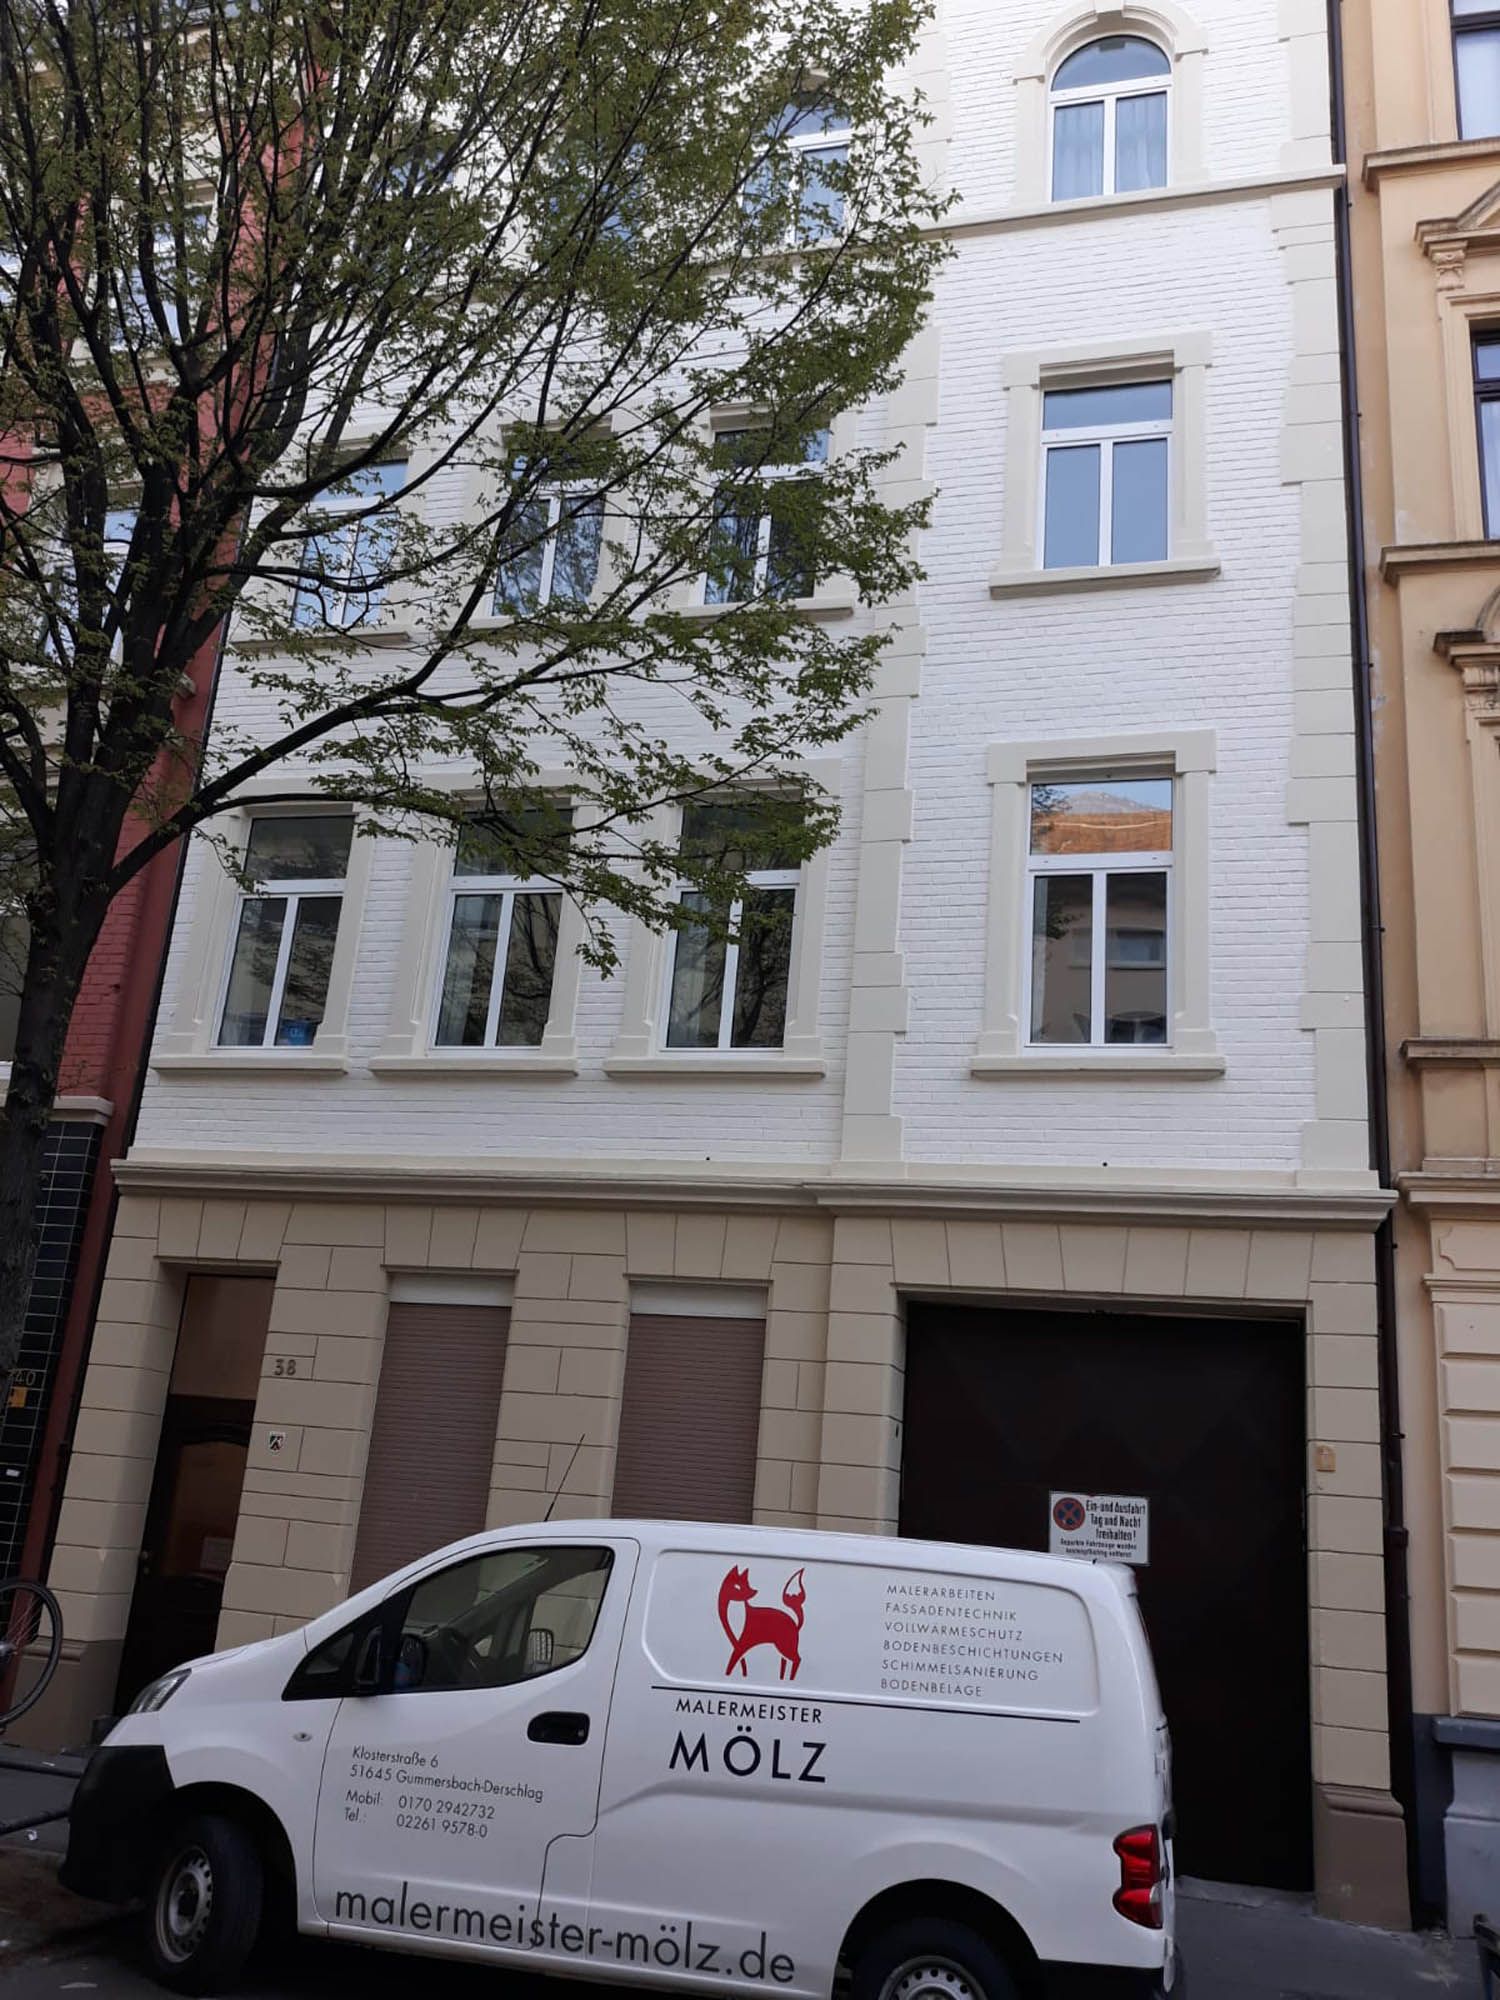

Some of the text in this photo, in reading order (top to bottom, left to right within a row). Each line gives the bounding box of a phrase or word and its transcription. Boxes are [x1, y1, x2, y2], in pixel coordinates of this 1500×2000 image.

[274, 1358, 297, 1376] 38
[1090, 1513, 1141, 1528] Tag und Nacht
[886, 1585, 995, 1601] MALERARBEITEN
[885, 1602, 1017, 1621] FASSADENTECHNIK
[883, 1640, 1064, 1663] BODENBESCHICHTUNGEN
[881, 1659, 1039, 1681] SCHIMMELSANIERUNG
[675, 1698, 822, 1723] MALERMEISTER
[352, 1745, 439, 1768] Klosterstraße 6
[669, 1725, 827, 1783] MÖLZ
[350, 1764, 544, 1803] 51645 Gummersbach-Derschlag
[398, 1795, 432, 1812] 0170
[436, 1800, 495, 1820] 2942732
[396, 1814, 436, 1831] 02261
[442, 1820, 488, 1838] 9578-0
[334, 1880, 796, 1983] malermeister-mölz.de
